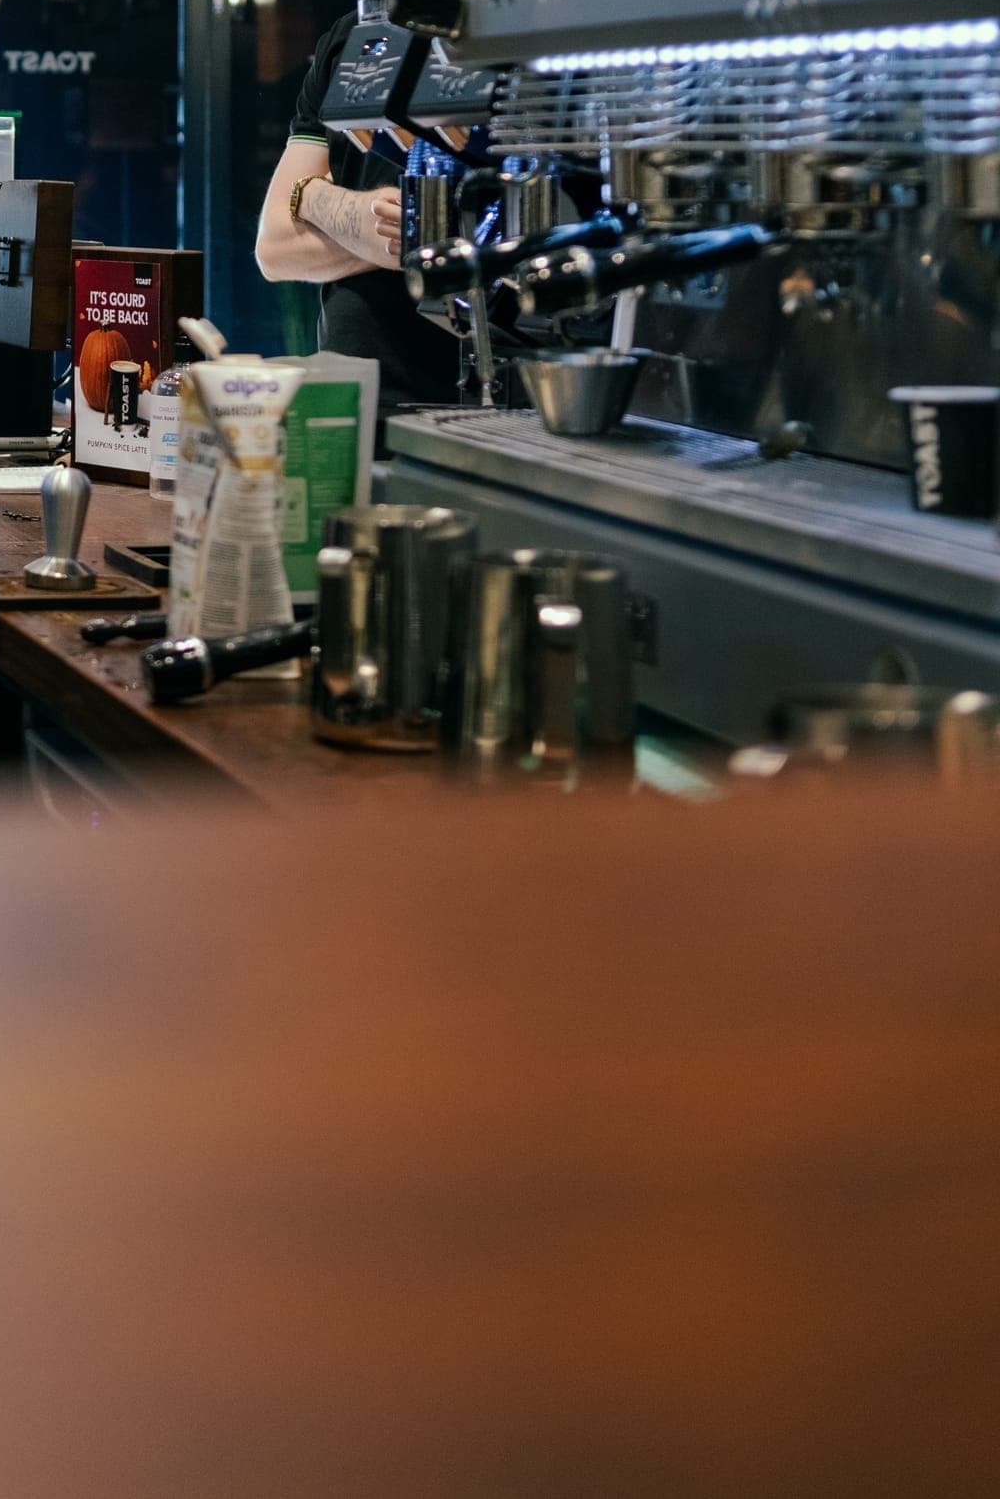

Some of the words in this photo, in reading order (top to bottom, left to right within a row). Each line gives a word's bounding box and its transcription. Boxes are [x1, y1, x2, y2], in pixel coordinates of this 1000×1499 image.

[135, 277, 152, 286] TOAST
[89, 290, 107, 306] IT'S
[109, 291, 146, 308] GOURD
[86, 307, 101, 322] TO
[102, 308, 116, 323] BE
[118, 309, 149, 326] BACK!
[121, 374, 130, 422] TOAST
[87, 439, 113, 450] PUMPKIN
[114, 443, 131, 452] SPICE
[131, 445, 148, 455] LATTE
